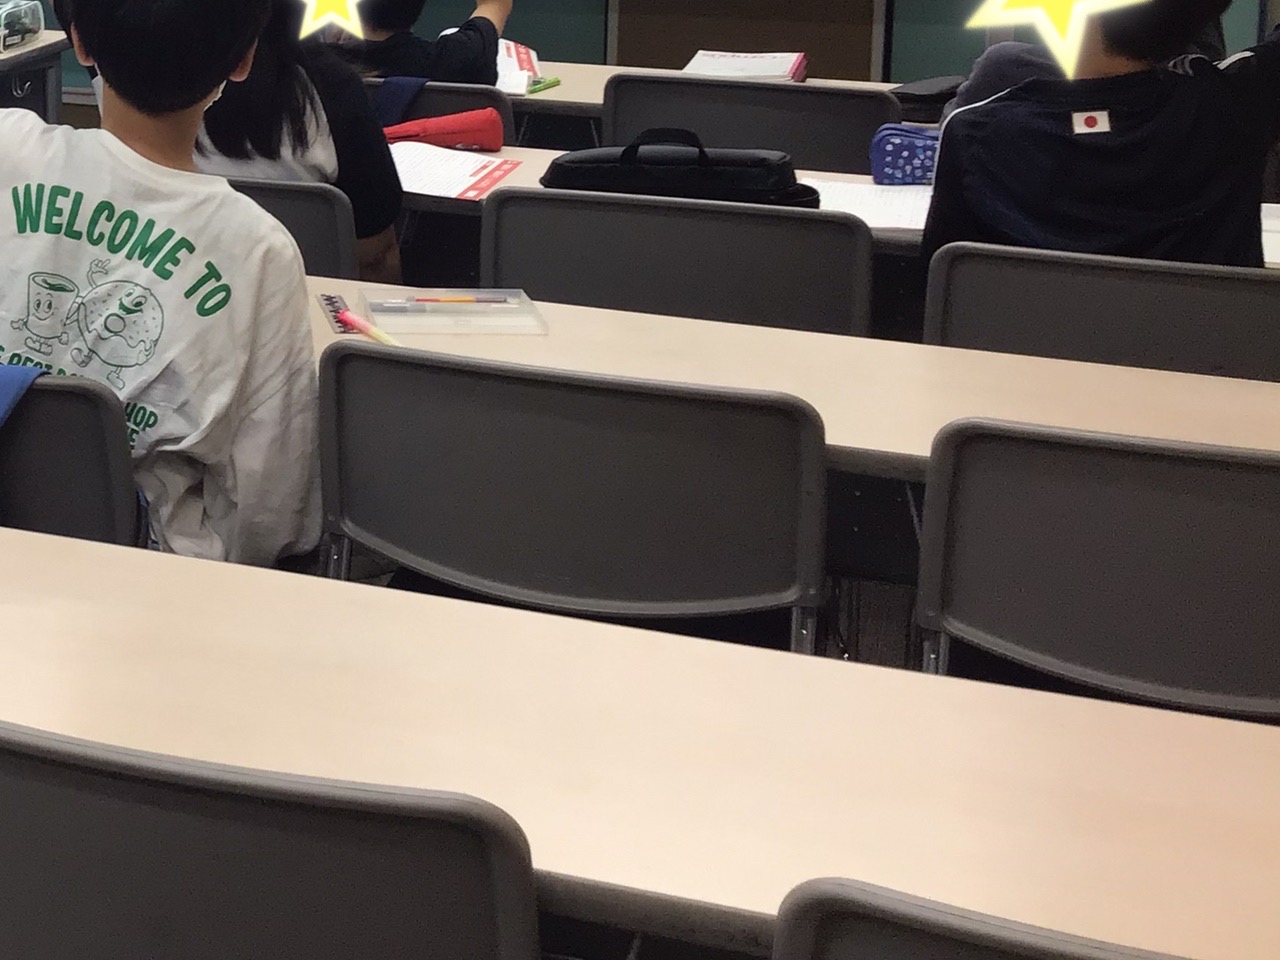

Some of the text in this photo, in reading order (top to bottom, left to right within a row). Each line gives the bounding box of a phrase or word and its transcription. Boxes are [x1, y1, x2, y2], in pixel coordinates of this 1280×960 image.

[11, 183, 232, 318] WELCOME TO
[124, 402, 158, 431] HOP
